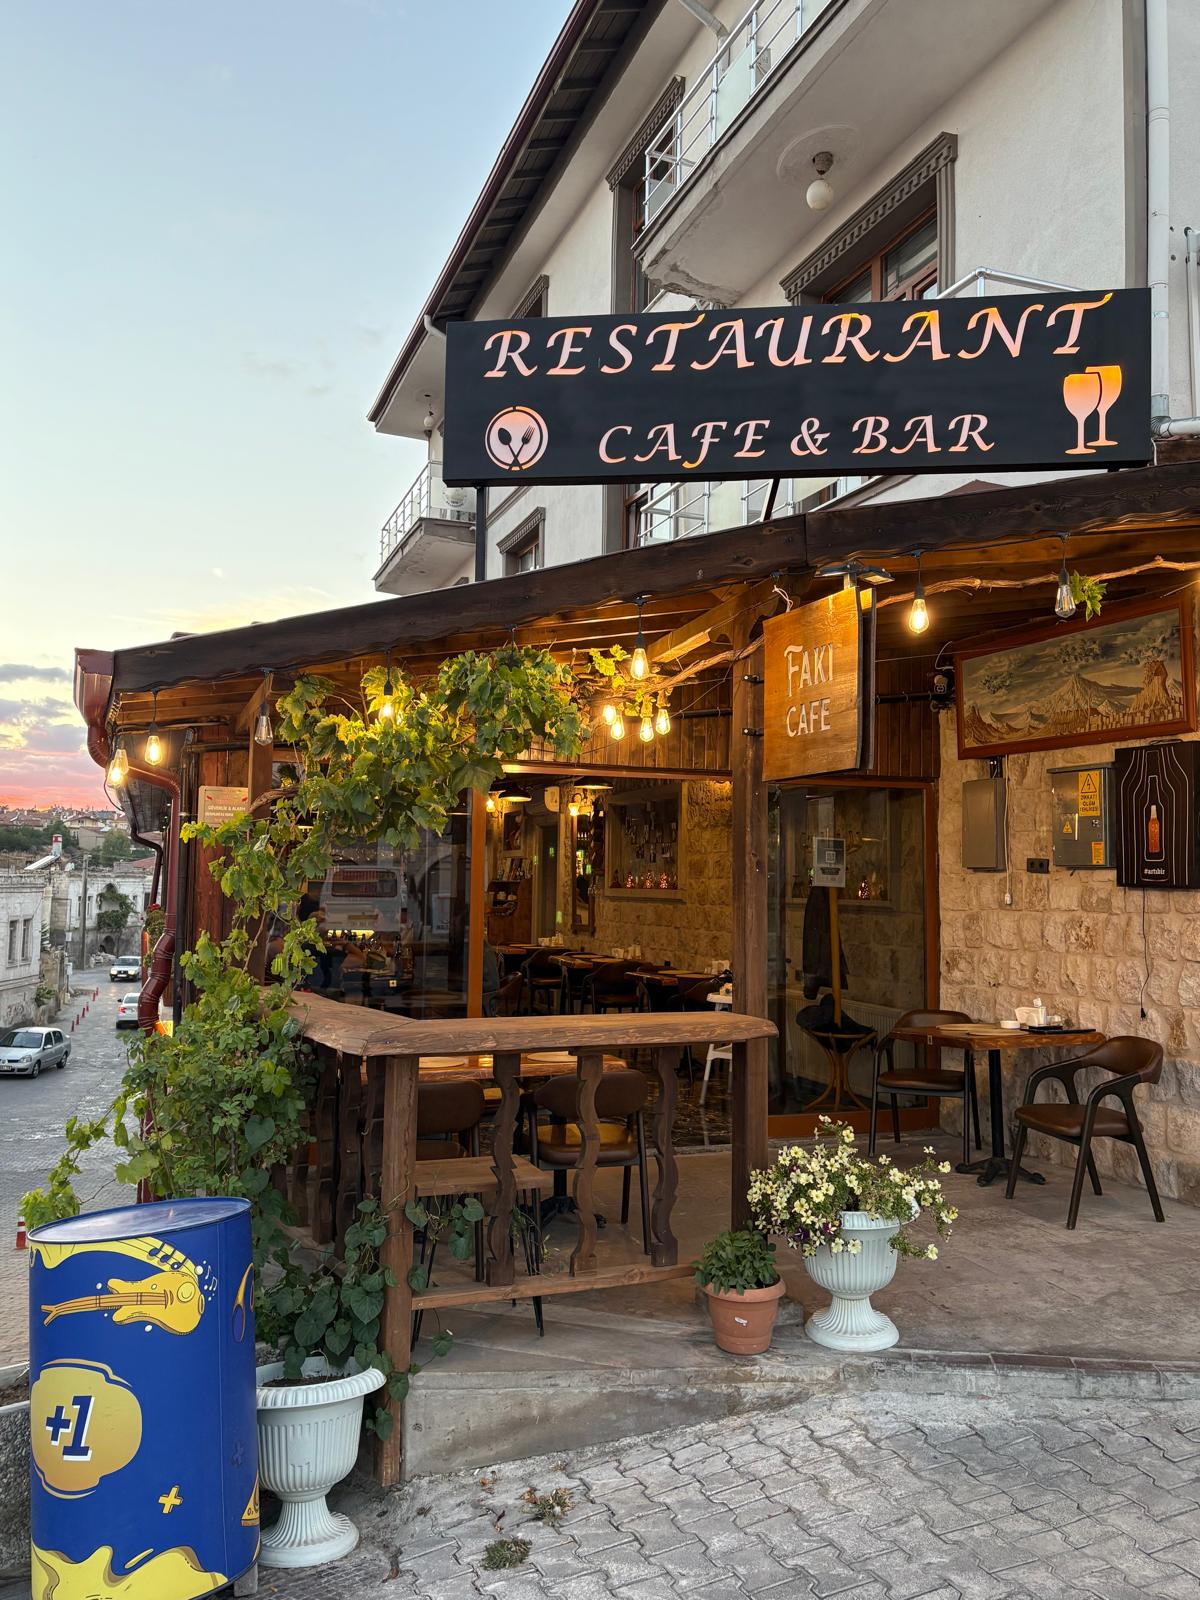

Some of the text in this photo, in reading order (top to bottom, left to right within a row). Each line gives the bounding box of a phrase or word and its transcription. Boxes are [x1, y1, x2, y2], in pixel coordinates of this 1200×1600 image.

[483, 293, 1114, 379] RESTAURANT
[598, 413, 995, 470] CAFE & BAR
[784, 642, 834, 697] FAKI
[786, 697, 831, 738] CAFE
[45, 1395, 95, 1462] +1
